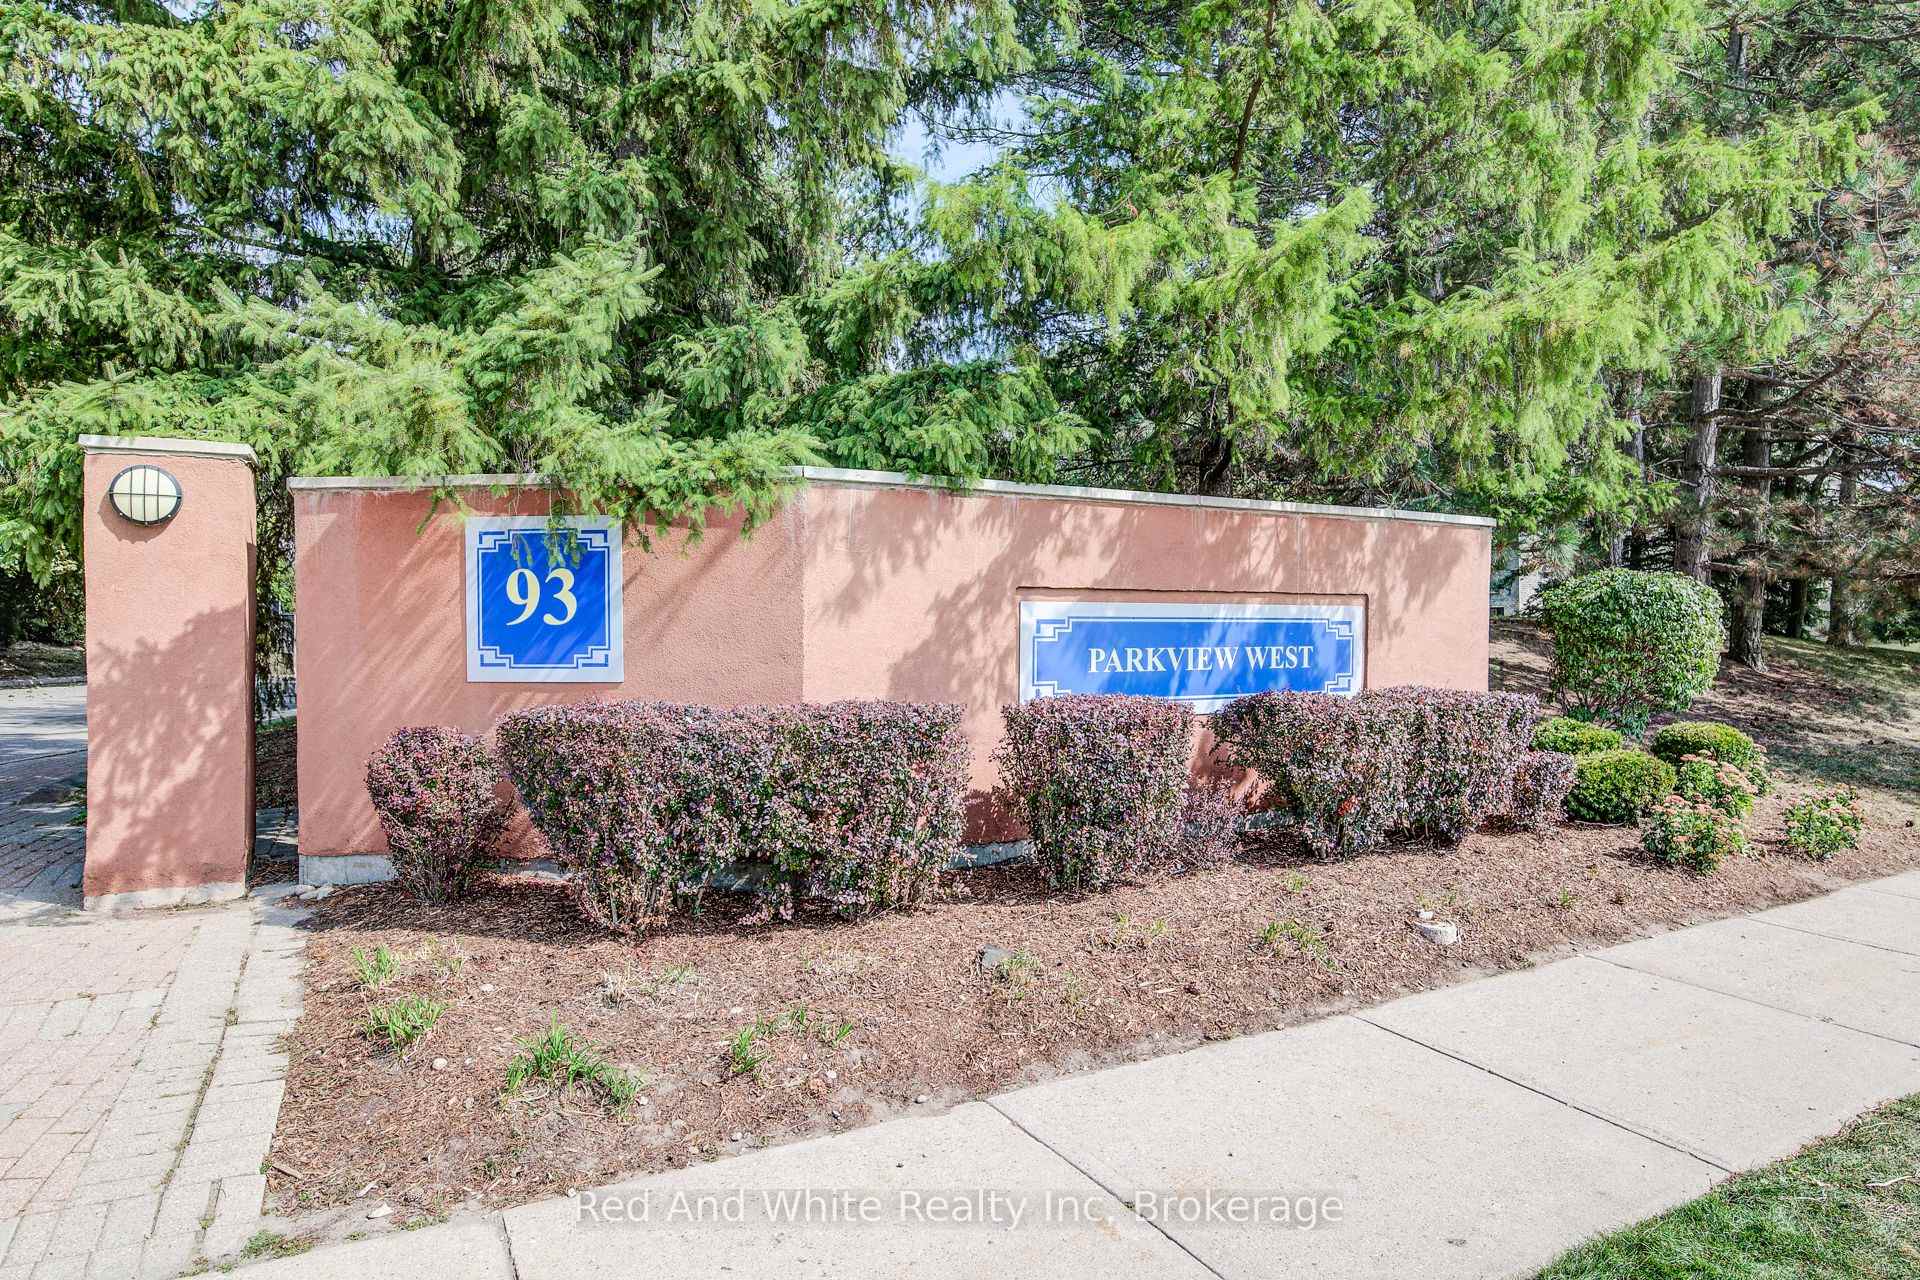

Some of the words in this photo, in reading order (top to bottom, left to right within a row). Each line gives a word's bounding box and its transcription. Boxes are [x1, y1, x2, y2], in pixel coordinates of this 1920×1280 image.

[506, 567, 578, 626] 93
[1087, 646, 1239, 673] PARKVIEW
[1246, 645, 1313, 669] WEST
